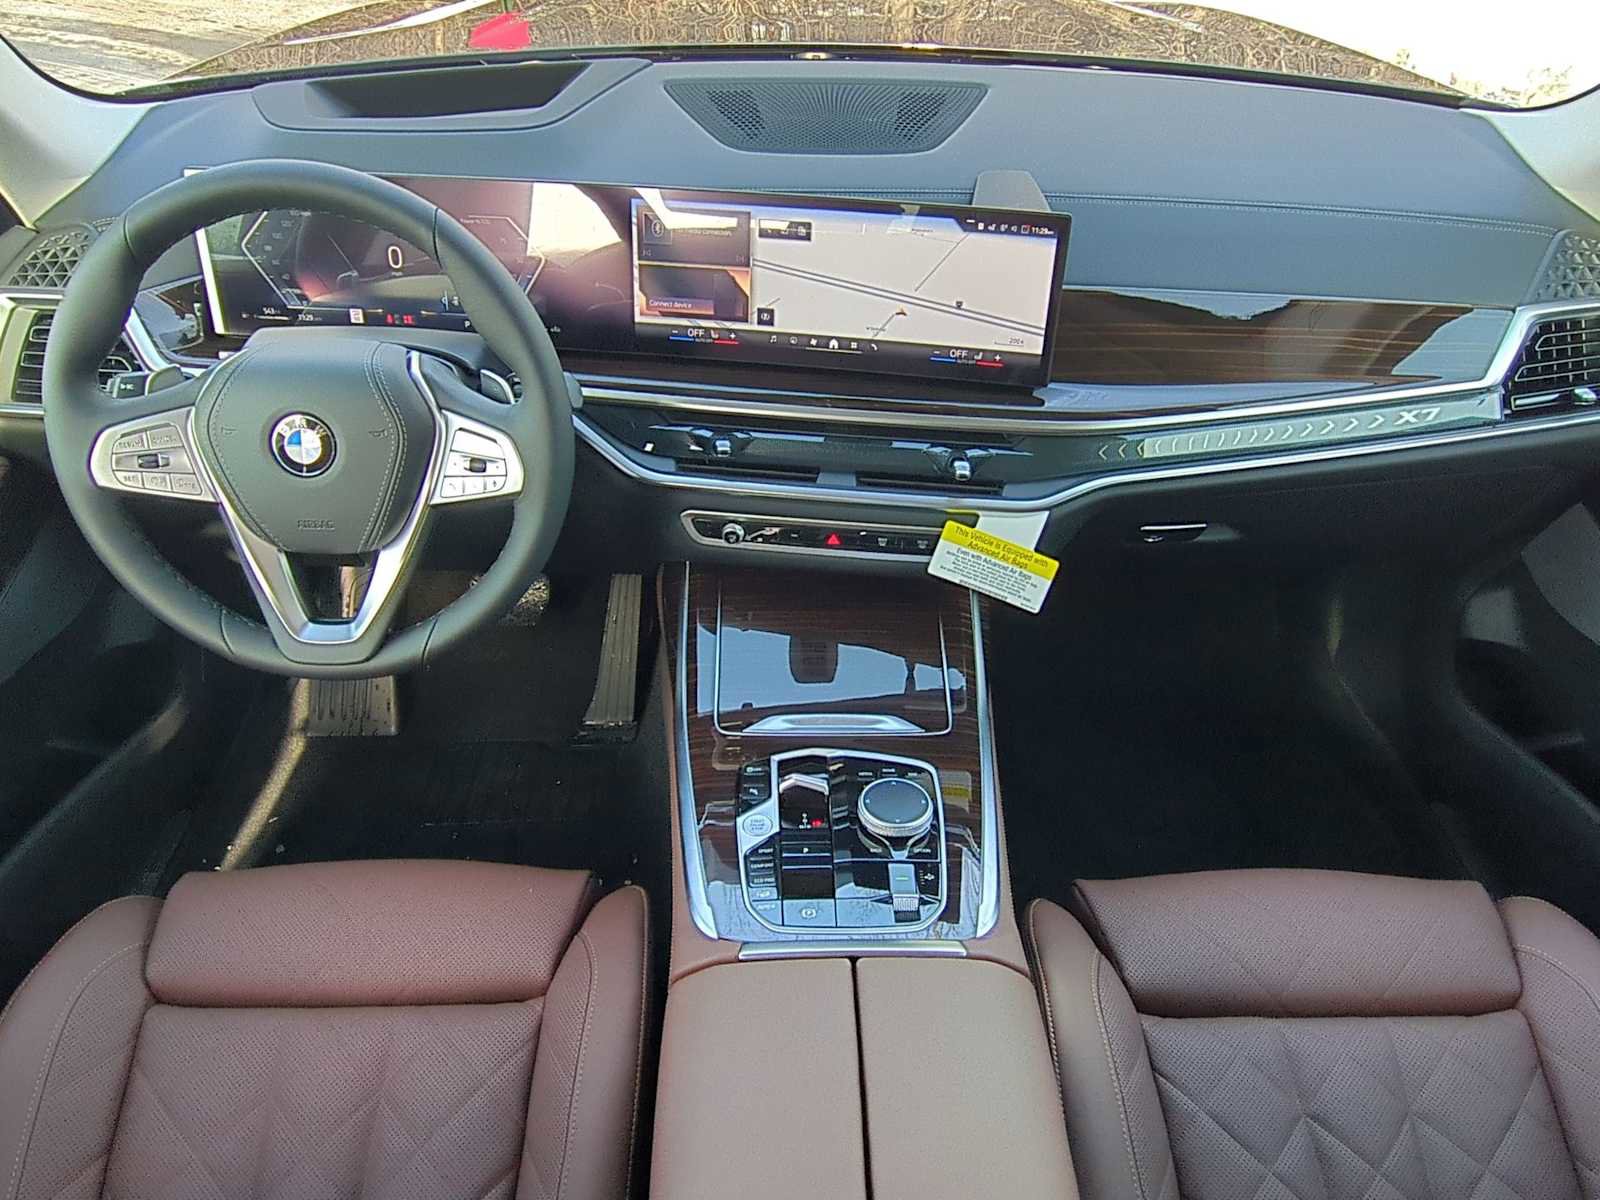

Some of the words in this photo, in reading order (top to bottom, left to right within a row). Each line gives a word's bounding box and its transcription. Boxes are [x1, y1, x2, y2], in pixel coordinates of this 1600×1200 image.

[387, 246, 403, 269] 0
[687, 328, 705, 338] OFF
[949, 349, 968, 359] OFF
[1393, 406, 1441, 425] X7
[954, 526, 969, 537] This
[969, 531, 994, 547] Vehicle
[1001, 543, 1033, 562] Equipped
[1033, 556, 1049, 568] with
[967, 540, 1000, 558] Advanced
[1011, 557, 1028, 569] Bags
